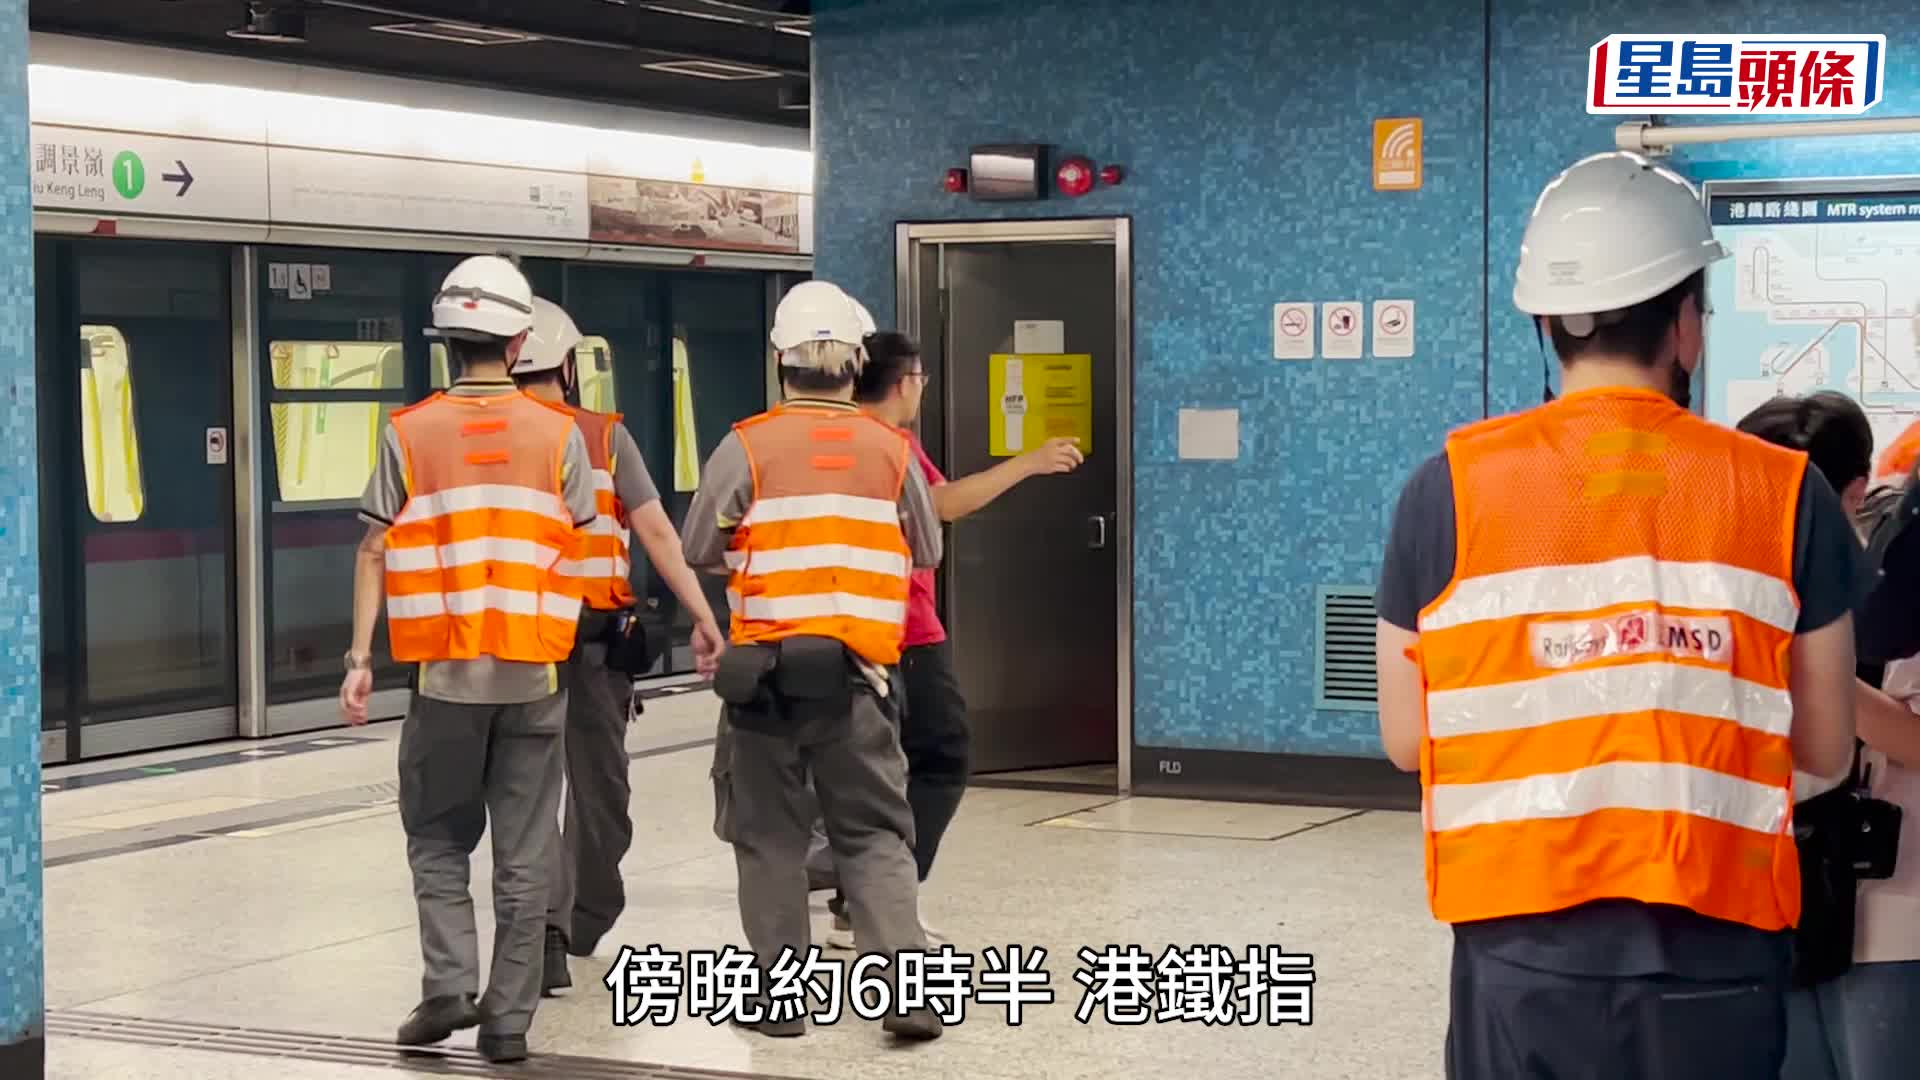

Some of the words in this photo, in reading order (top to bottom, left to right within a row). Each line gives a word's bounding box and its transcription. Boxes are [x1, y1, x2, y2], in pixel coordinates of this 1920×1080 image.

[122, 159, 133, 191] 1
[46, 181, 76, 200] Keng
[78, 184, 105, 202] Leng
[1826, 202, 1857, 217] MTR
[1858, 202, 1906, 218] system
